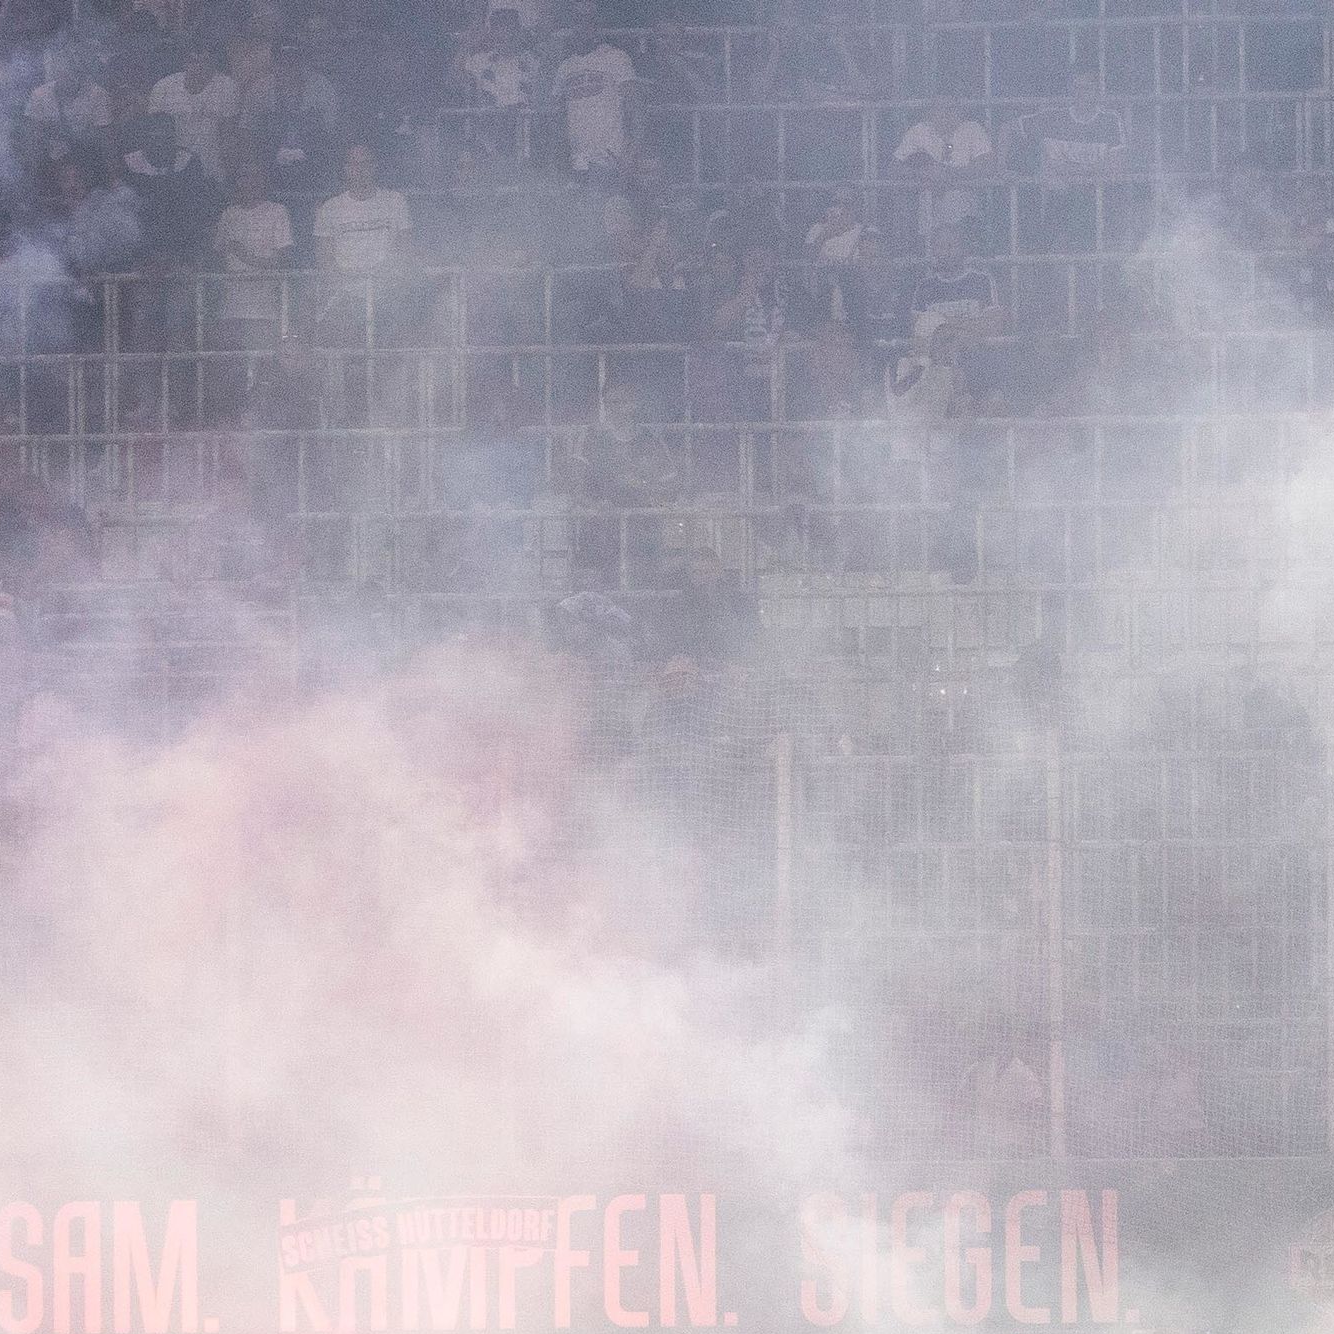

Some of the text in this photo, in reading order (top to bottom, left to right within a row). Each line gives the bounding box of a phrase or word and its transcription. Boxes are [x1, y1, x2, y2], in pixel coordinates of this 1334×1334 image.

[278, 1175, 738, 1333] KÄMPFEN.
[799, 1188, 1140, 1327] SIEGEN.
[396, 1205, 558, 1246] HÜTTELDORF
